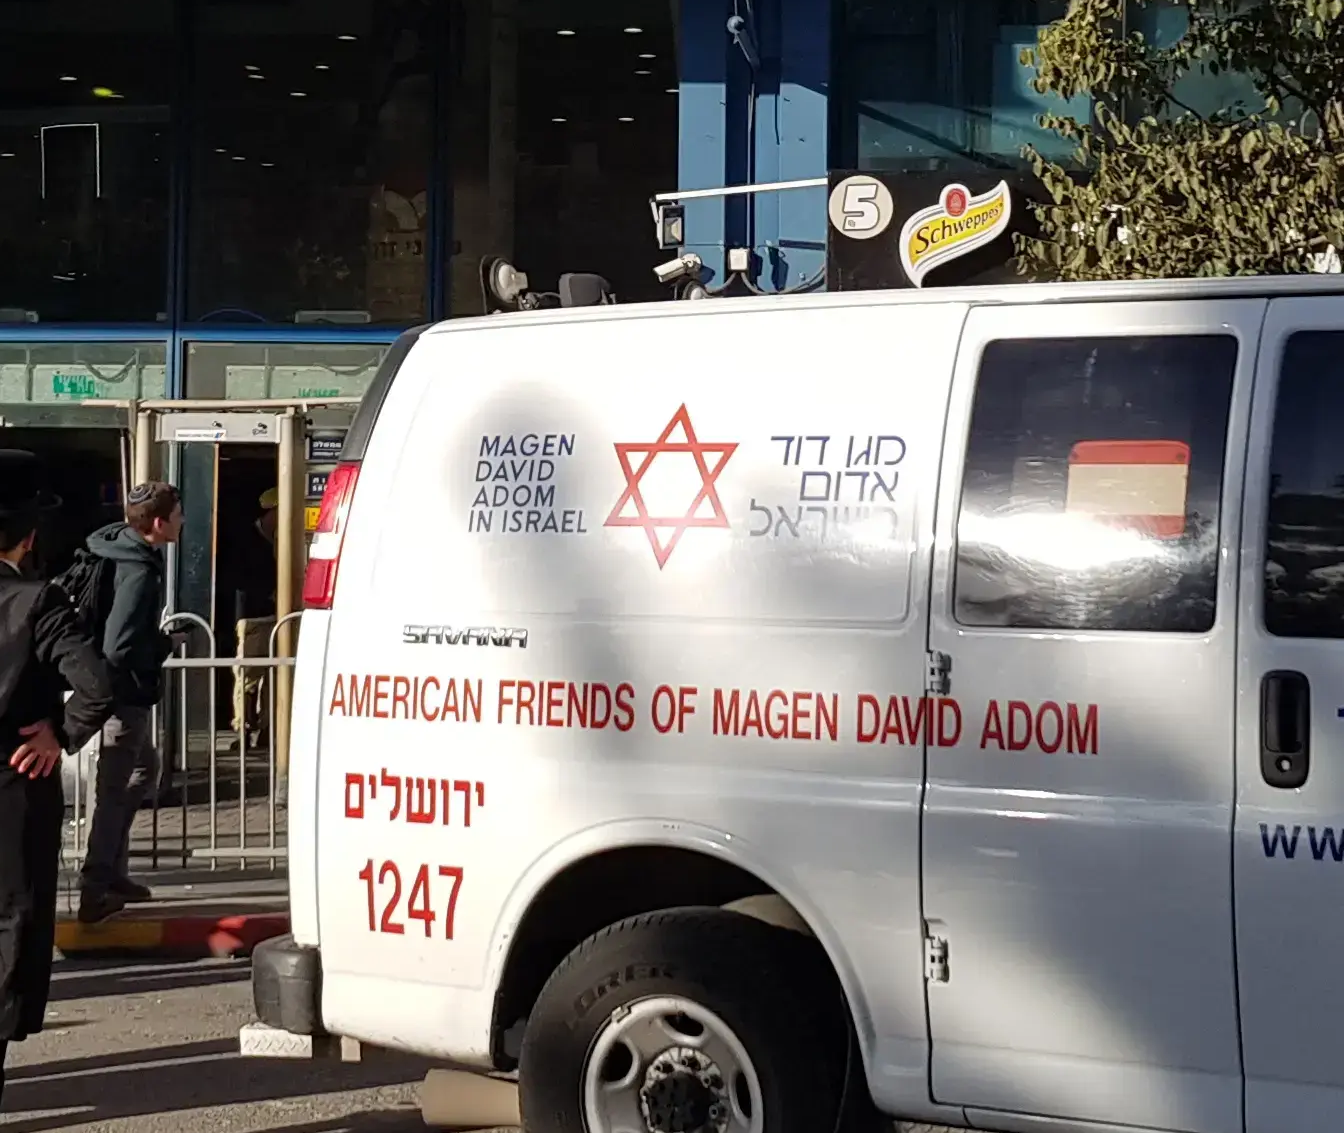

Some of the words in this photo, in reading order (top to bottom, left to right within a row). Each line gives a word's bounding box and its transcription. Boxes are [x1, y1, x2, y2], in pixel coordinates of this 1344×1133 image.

[841, 183, 881, 232] 5
[914, 205, 1001, 255] Schweppes
[478, 433, 576, 458] MAGEN
[770, 435, 831, 466] דוד
[845, 435, 907, 468] מגן
[474, 460, 555, 483] DAVID
[799, 471, 900, 503] אדום
[471, 484, 555, 508] ADOM
[468, 509, 493, 533] IN
[501, 509, 588, 534] ISRAEL
[402, 623, 529, 649] SAVANA
[328, 672, 483, 723] AMERICAN
[496, 678, 636, 732] FRIENDS
[650, 682, 699, 735] OF
[712, 687, 839, 742] MAGEN
[855, 693, 963, 748] DAVID
[979, 699, 1099, 756] ADOM
[344, 767, 485, 828] ירושלים
[358, 857, 465, 941] 1247
